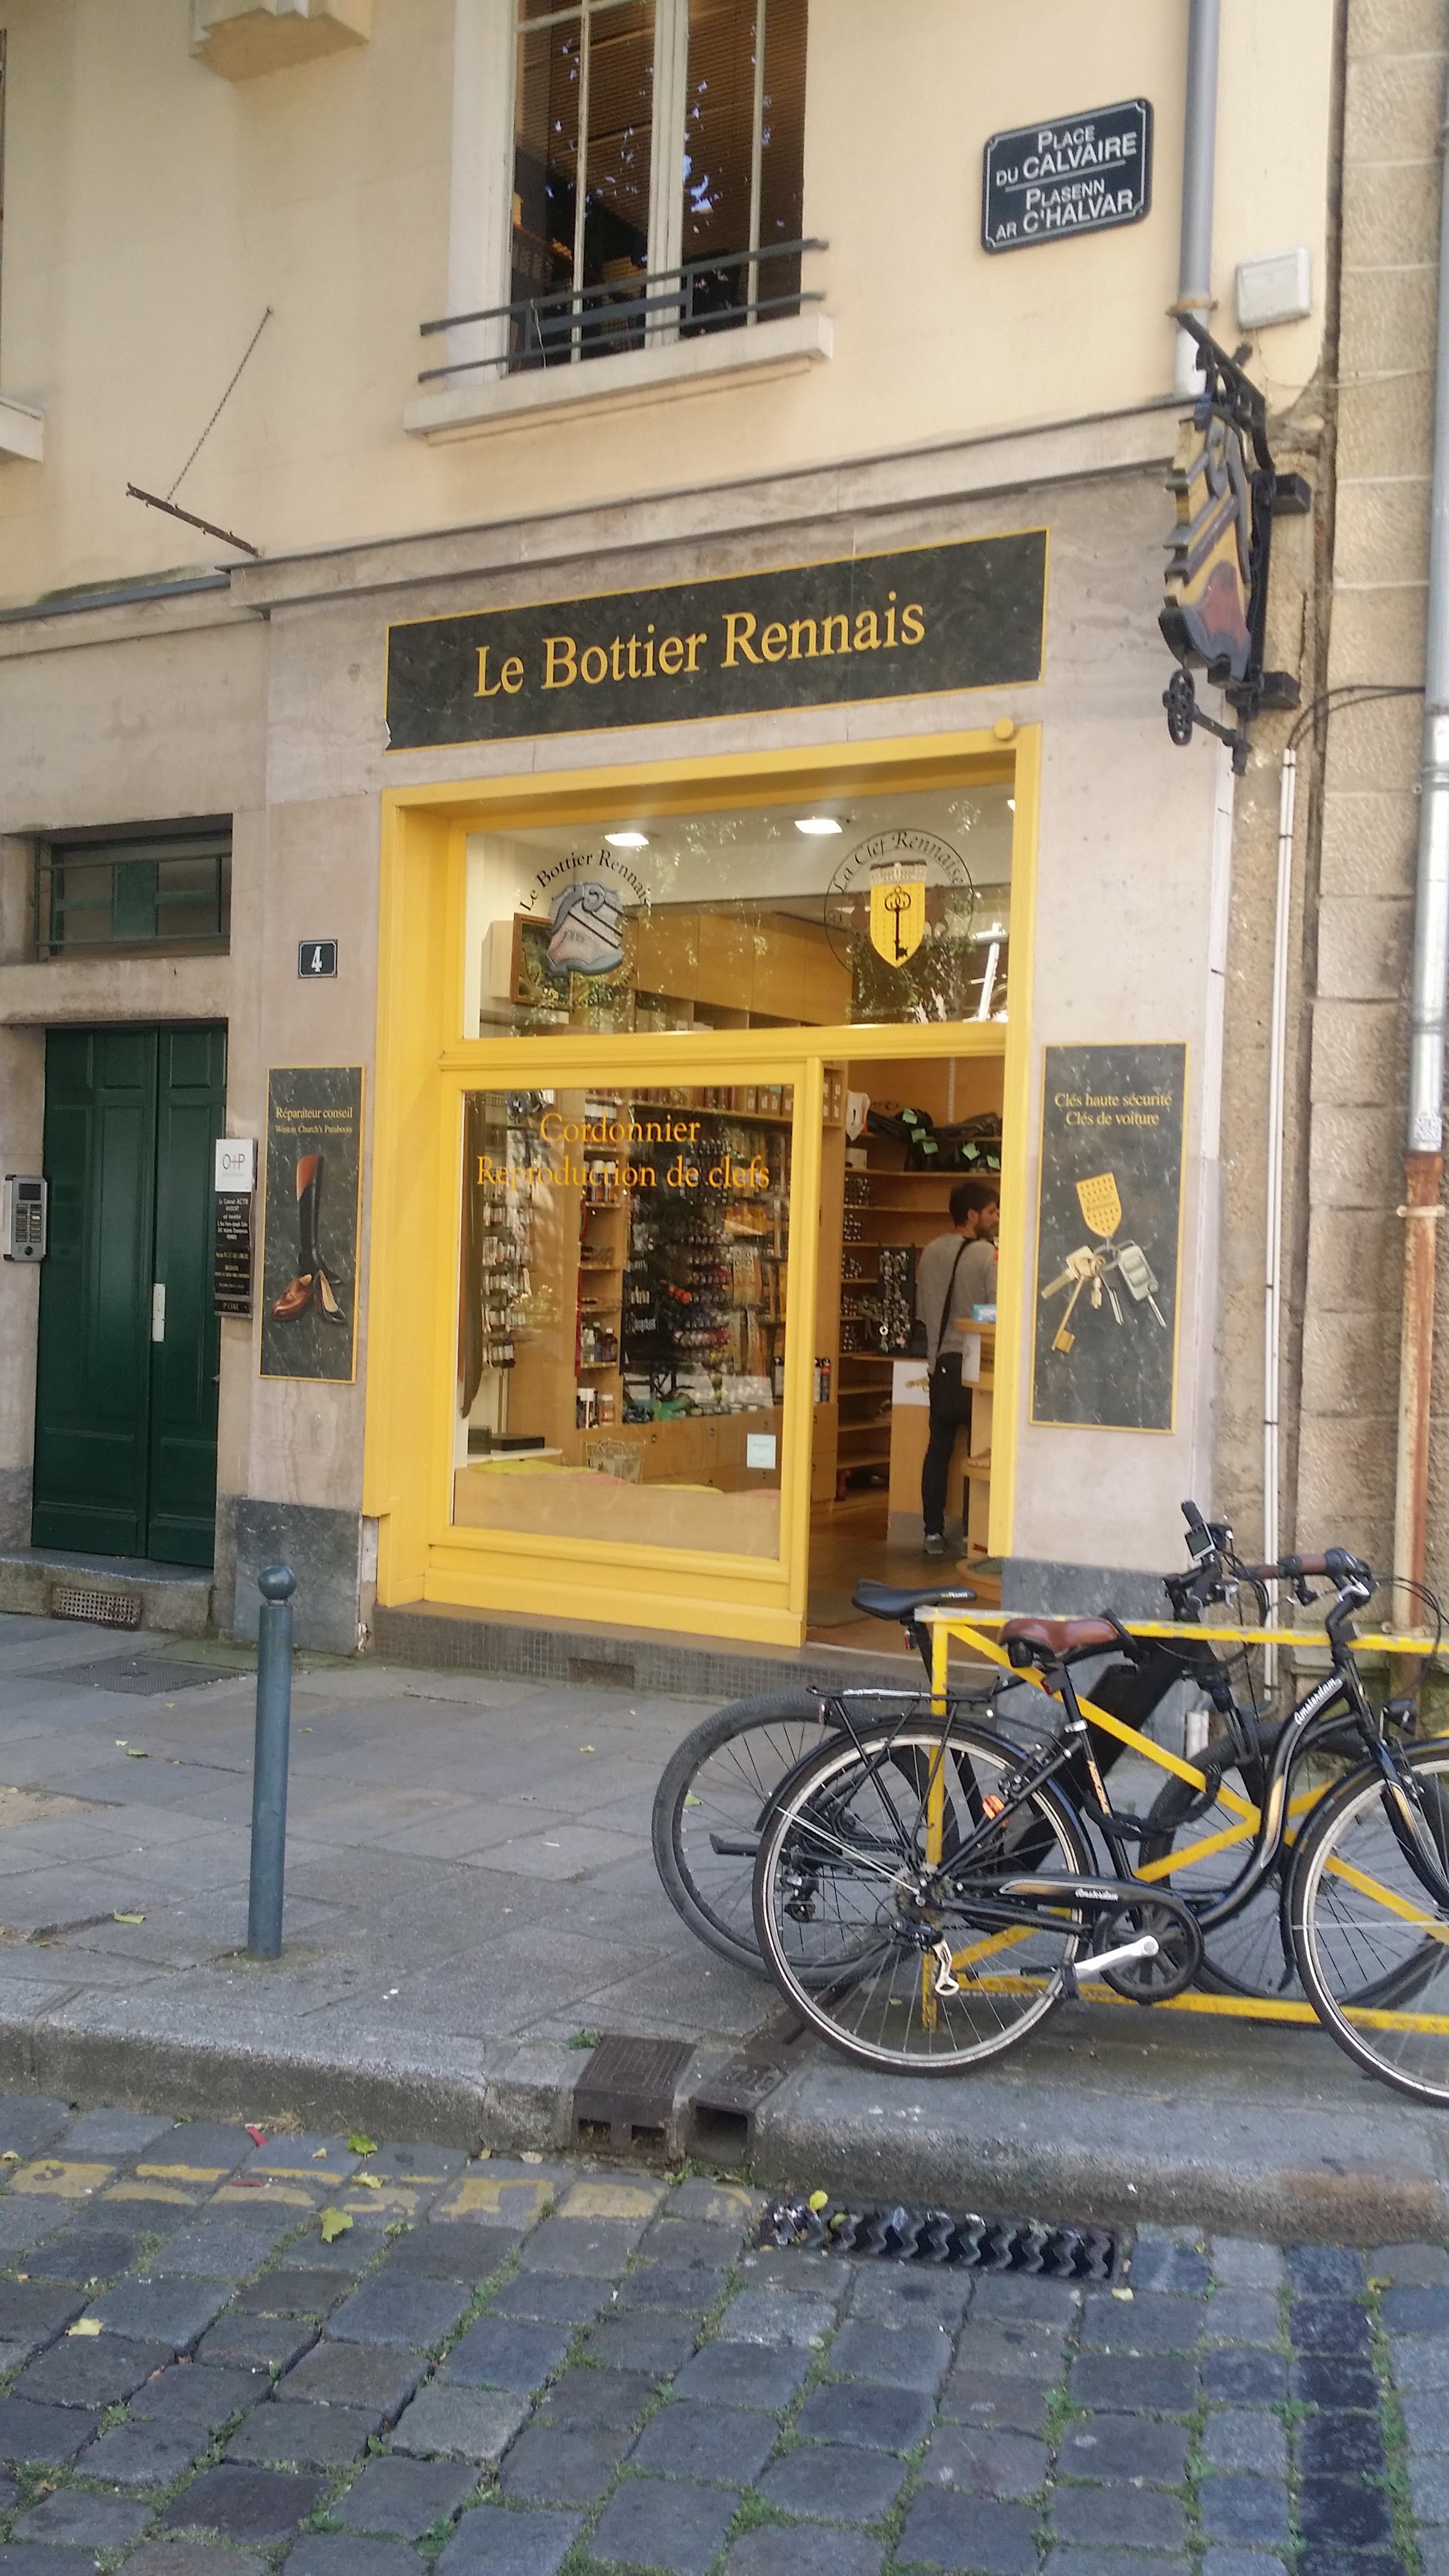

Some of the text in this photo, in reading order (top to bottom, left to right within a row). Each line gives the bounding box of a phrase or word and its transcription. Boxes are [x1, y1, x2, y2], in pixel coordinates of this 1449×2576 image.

[1038, 125, 1095, 154] PLACE
[996, 131, 1137, 186] DU CALVAIRE
[1026, 178, 1105, 210] PLASENN
[996, 189, 1133, 240] AR C'HALVAR
[474, 590, 926, 696] Le Bottier Rennais
[520, 849, 651, 911] Le Bottier Rennais
[834, 867, 853, 892] La
[855, 839, 884, 865] Clef
[311, 945, 323, 972] 4
[276, 1106, 353, 1121] Réparateur conseil
[1055, 1092, 1173, 1107] Clés haute sécurité
[540, 1112, 701, 1143] Cordonnier
[1066, 1111, 1159, 1125] Clés de voiture
[477, 1154, 769, 1191] Reproduction de clefs
